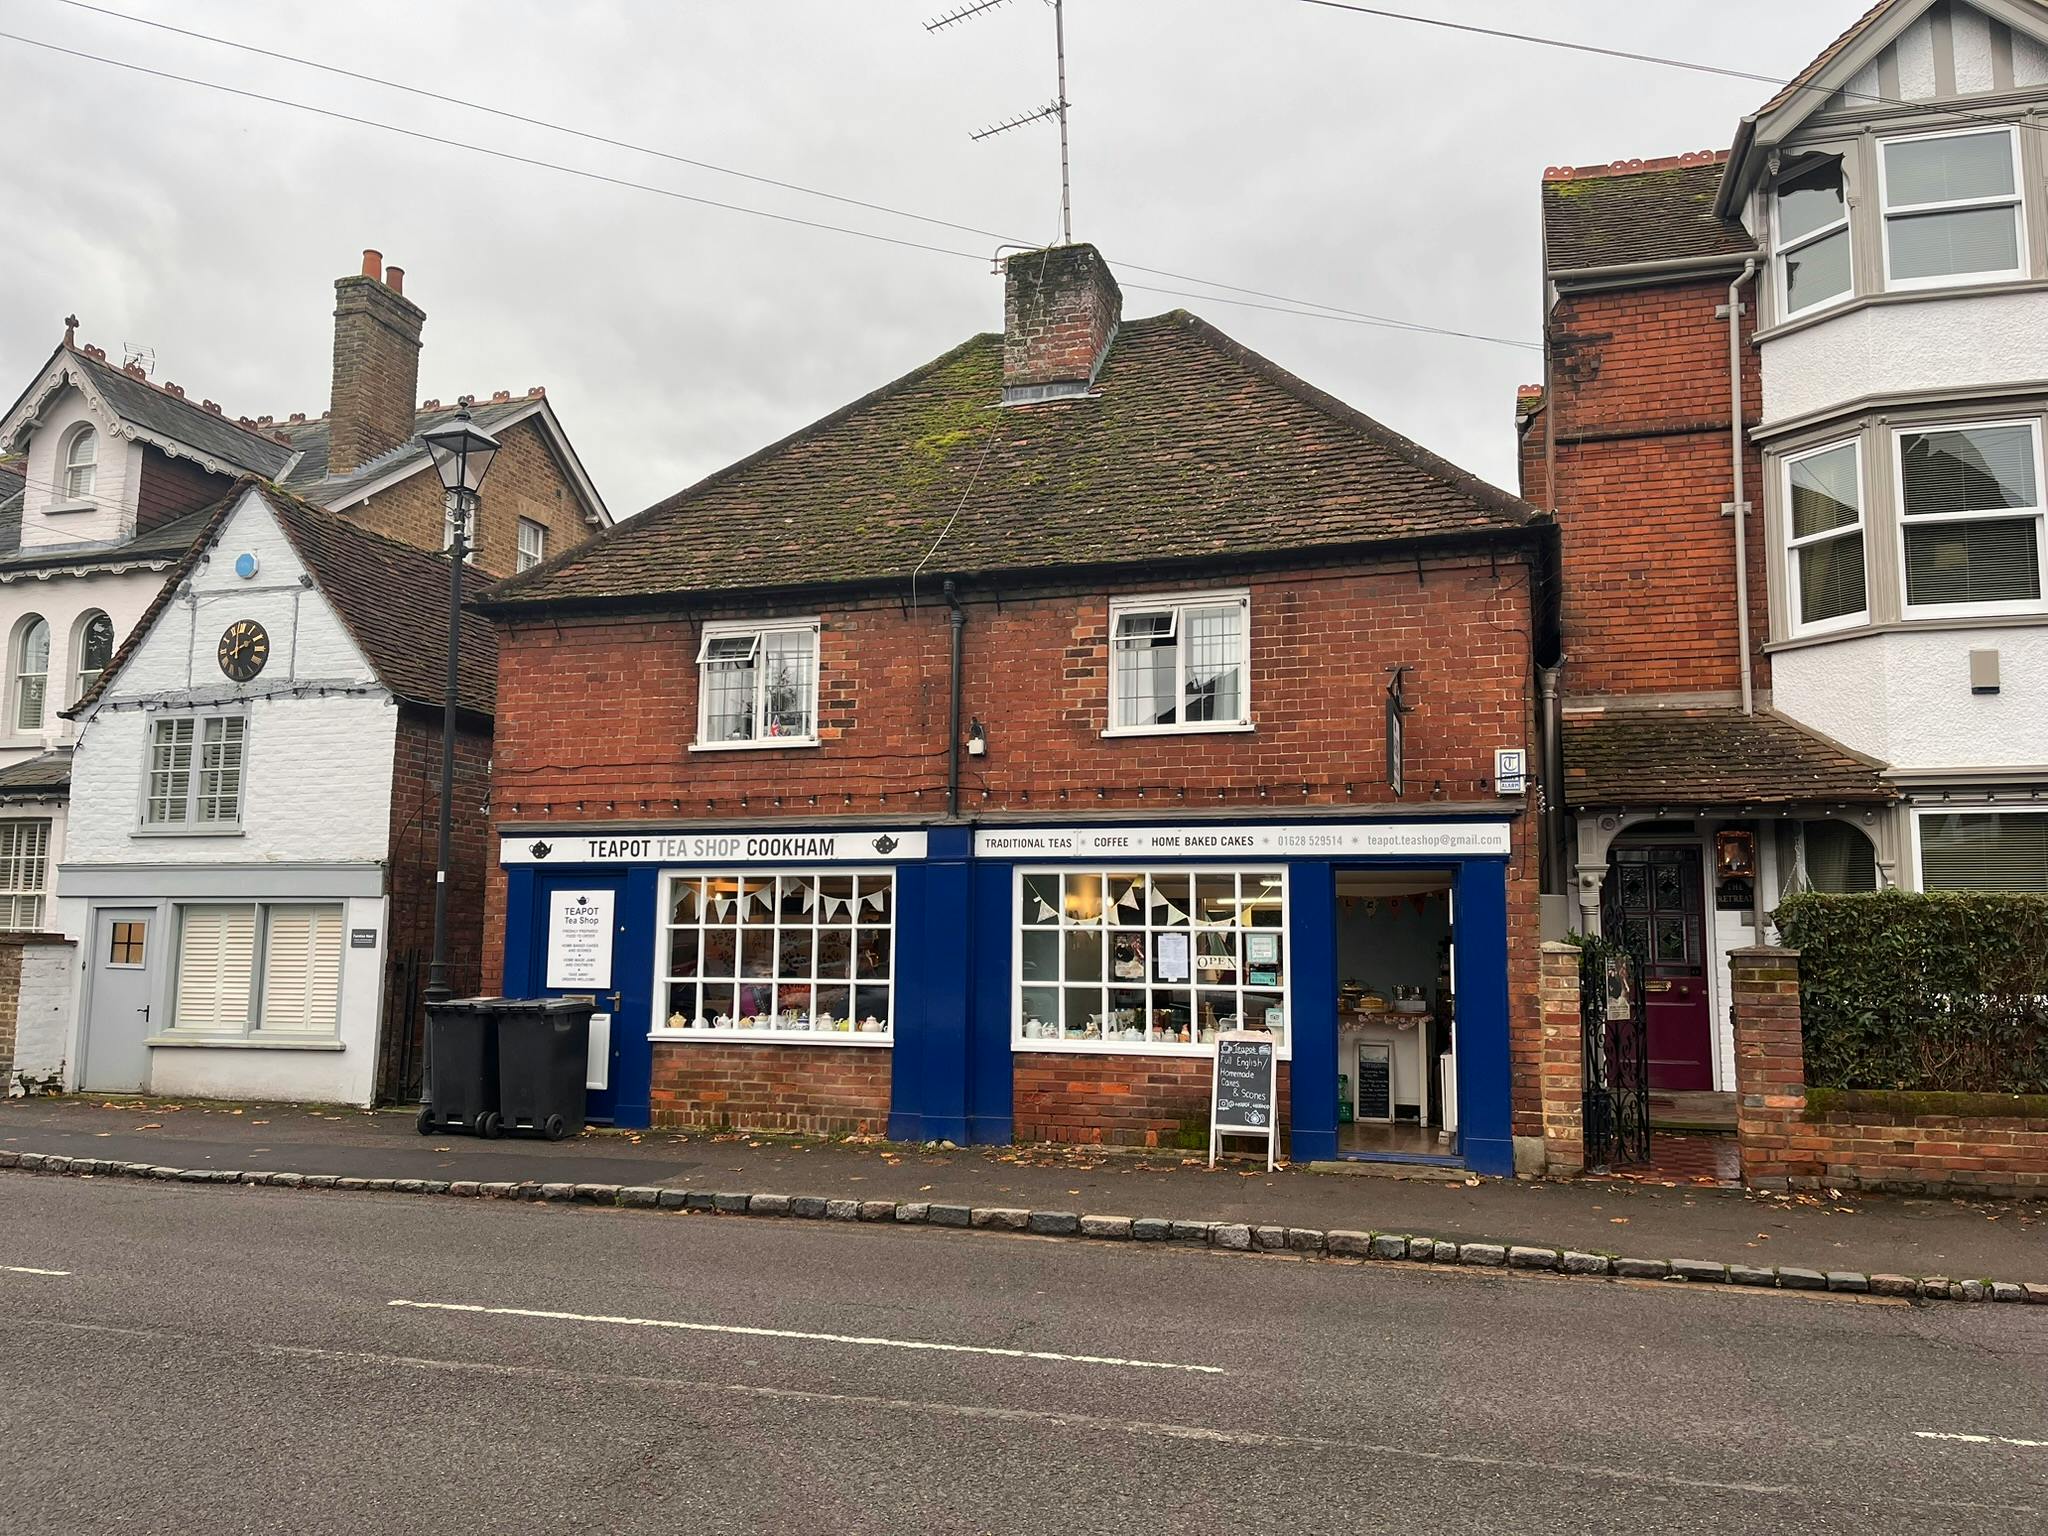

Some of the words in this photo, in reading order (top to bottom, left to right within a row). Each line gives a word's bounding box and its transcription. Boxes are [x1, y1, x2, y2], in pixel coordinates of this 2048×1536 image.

[985, 838, 1045, 848] TRADITIONAL
[1048, 838, 1072, 848] TEAS
[1094, 837, 1129, 847] COFFEE
[1151, 836, 1180, 847] HOME
[1184, 836, 1218, 847] BAKED
[1221, 836, 1254, 846] CAKES
[1278, 835, 1306, 846] 01628
[1309, 835, 1343, 846] 529514
[1368, 834, 1502, 847] teapot.teashop@gmail.com
[588, 840, 651, 858] TEAPOT
[657, 839, 687, 858] TEA
[693, 839, 741, 857] SHOP
[747, 838, 834, 857] COOKHAM
[564, 907, 599, 916] TEAPOT
[565, 916, 577, 925] Tea
[579, 916, 599, 926] Shop
[1198, 957, 1236, 968] OPEN
[1220, 1056, 1232, 1065] Full
[1220, 1067, 1255, 1079] Homemade
[1220, 1078, 1240, 1088] Cakes
[1232, 1088, 1239, 1097] &
[1241, 1089, 1266, 1101] Scones
